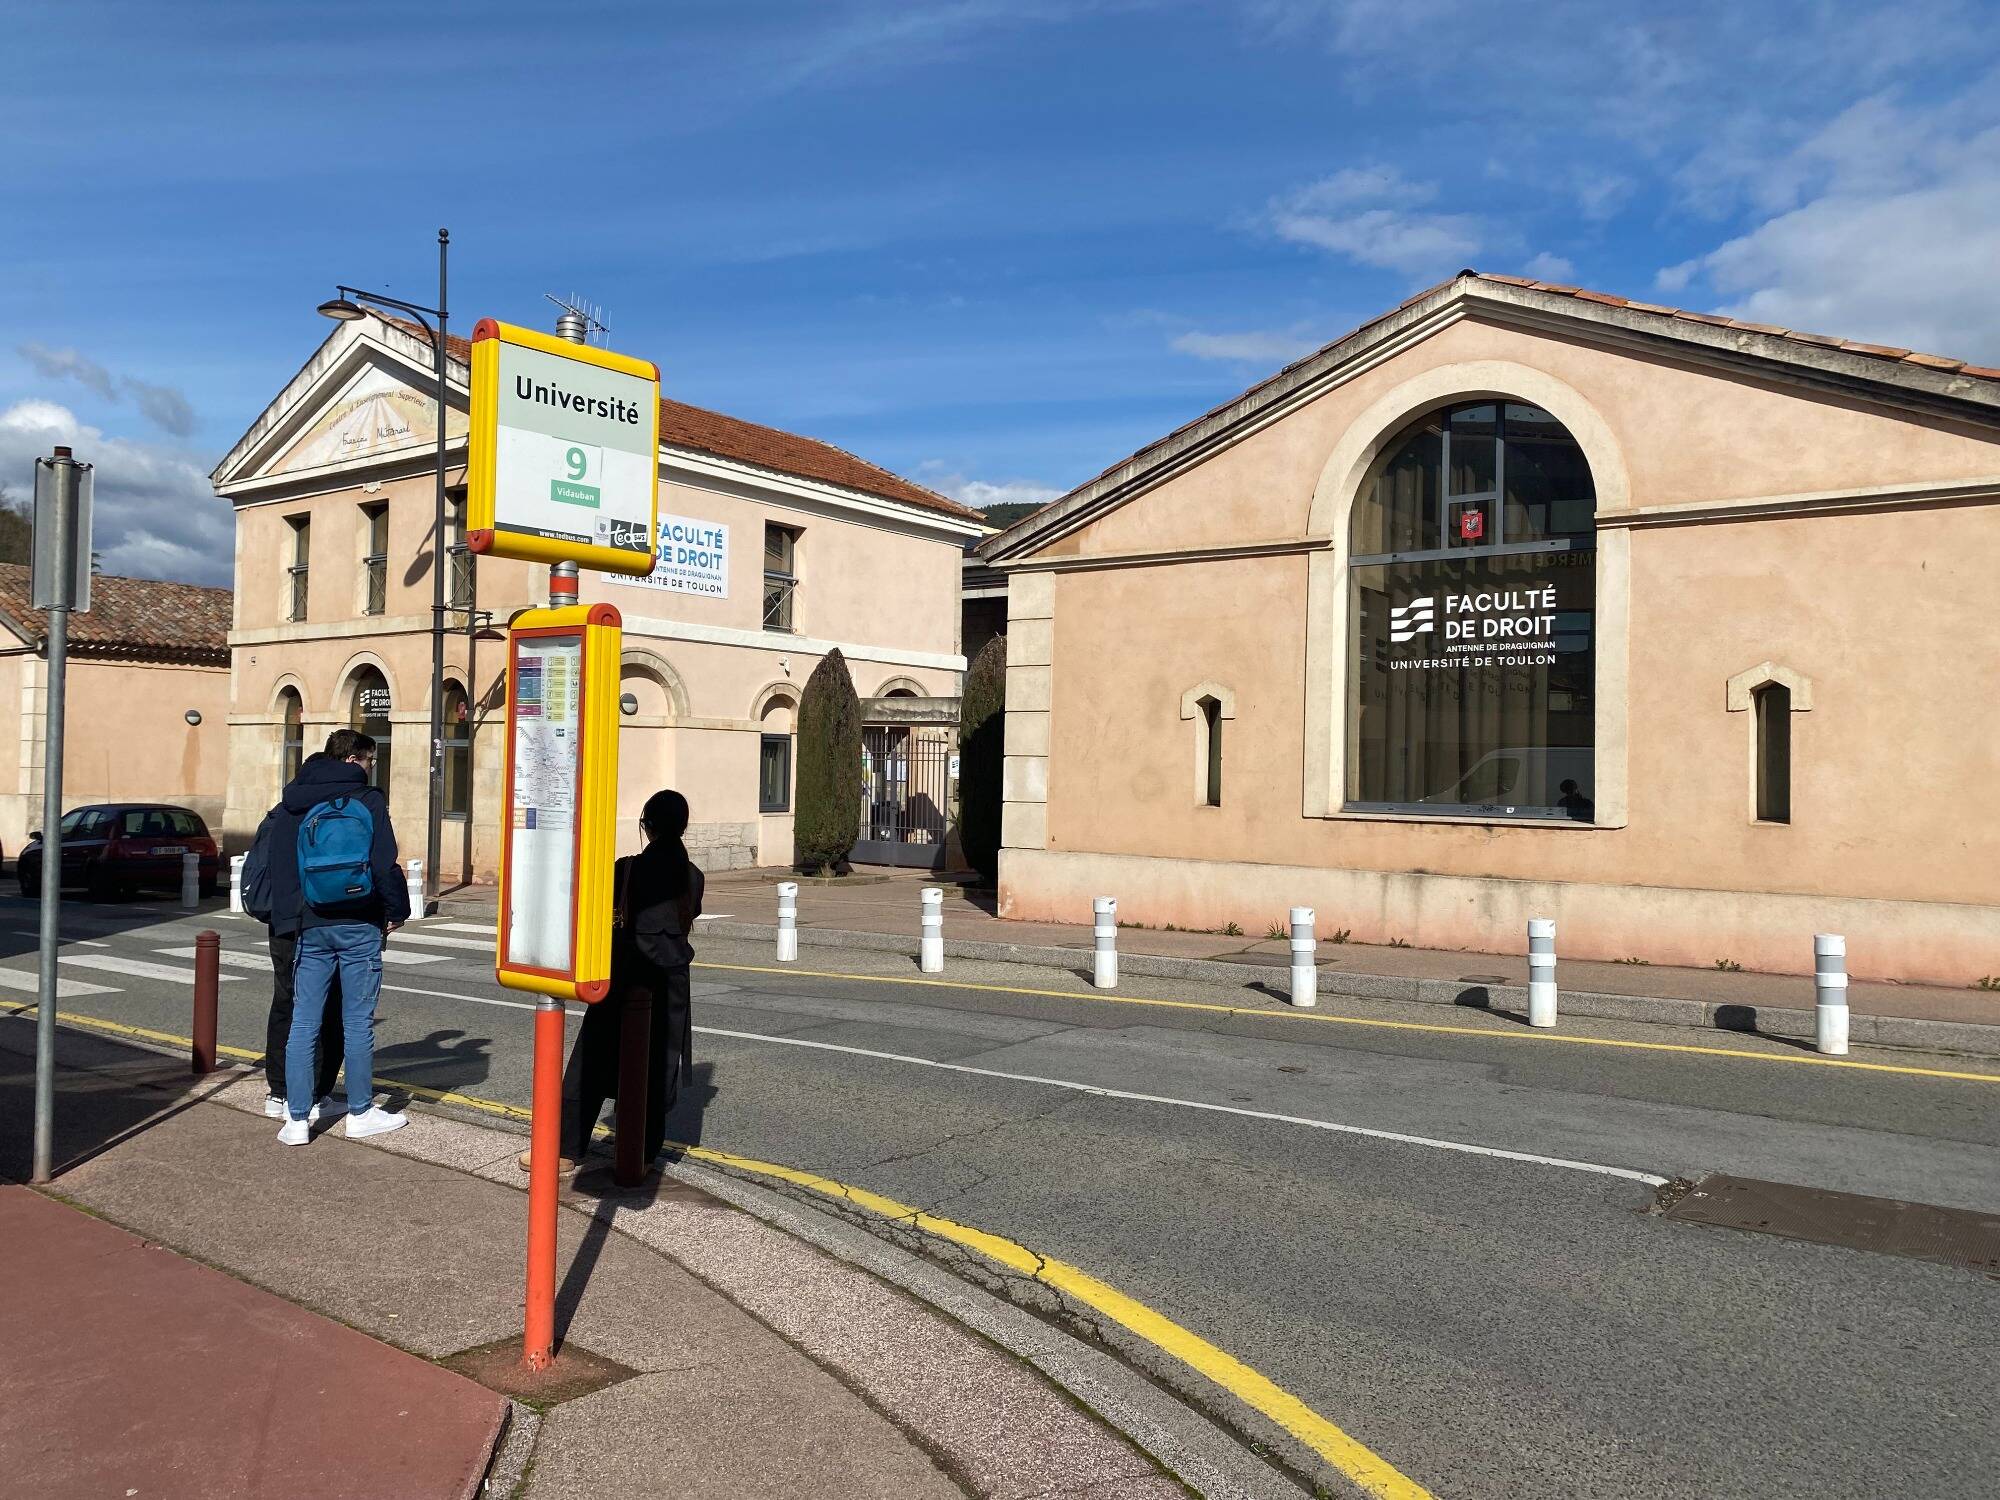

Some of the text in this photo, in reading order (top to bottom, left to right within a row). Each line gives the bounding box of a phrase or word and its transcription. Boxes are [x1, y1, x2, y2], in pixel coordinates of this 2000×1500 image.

[516, 375, 639, 425] Université
[566, 447, 587, 480] 9
[556, 486, 595, 501] Vidauban
[656, 545, 723, 570] DE DROIT
[656, 565, 678, 575] NTENNE
[671, 578, 683, 588] DE
[686, 581, 722, 593] TOULON
[1445, 584, 1557, 614] FACULTÉ
[1445, 615, 1556, 640] DE DROIT
[1445, 641, 1556, 653] ANTENNE DE DRAGUIGNAN
[1390, 655, 1556, 670] UNIVERSITÉ DE TOULON
[371, 689, 389, 697] FACUL
[379, 698, 391, 706] DRO
